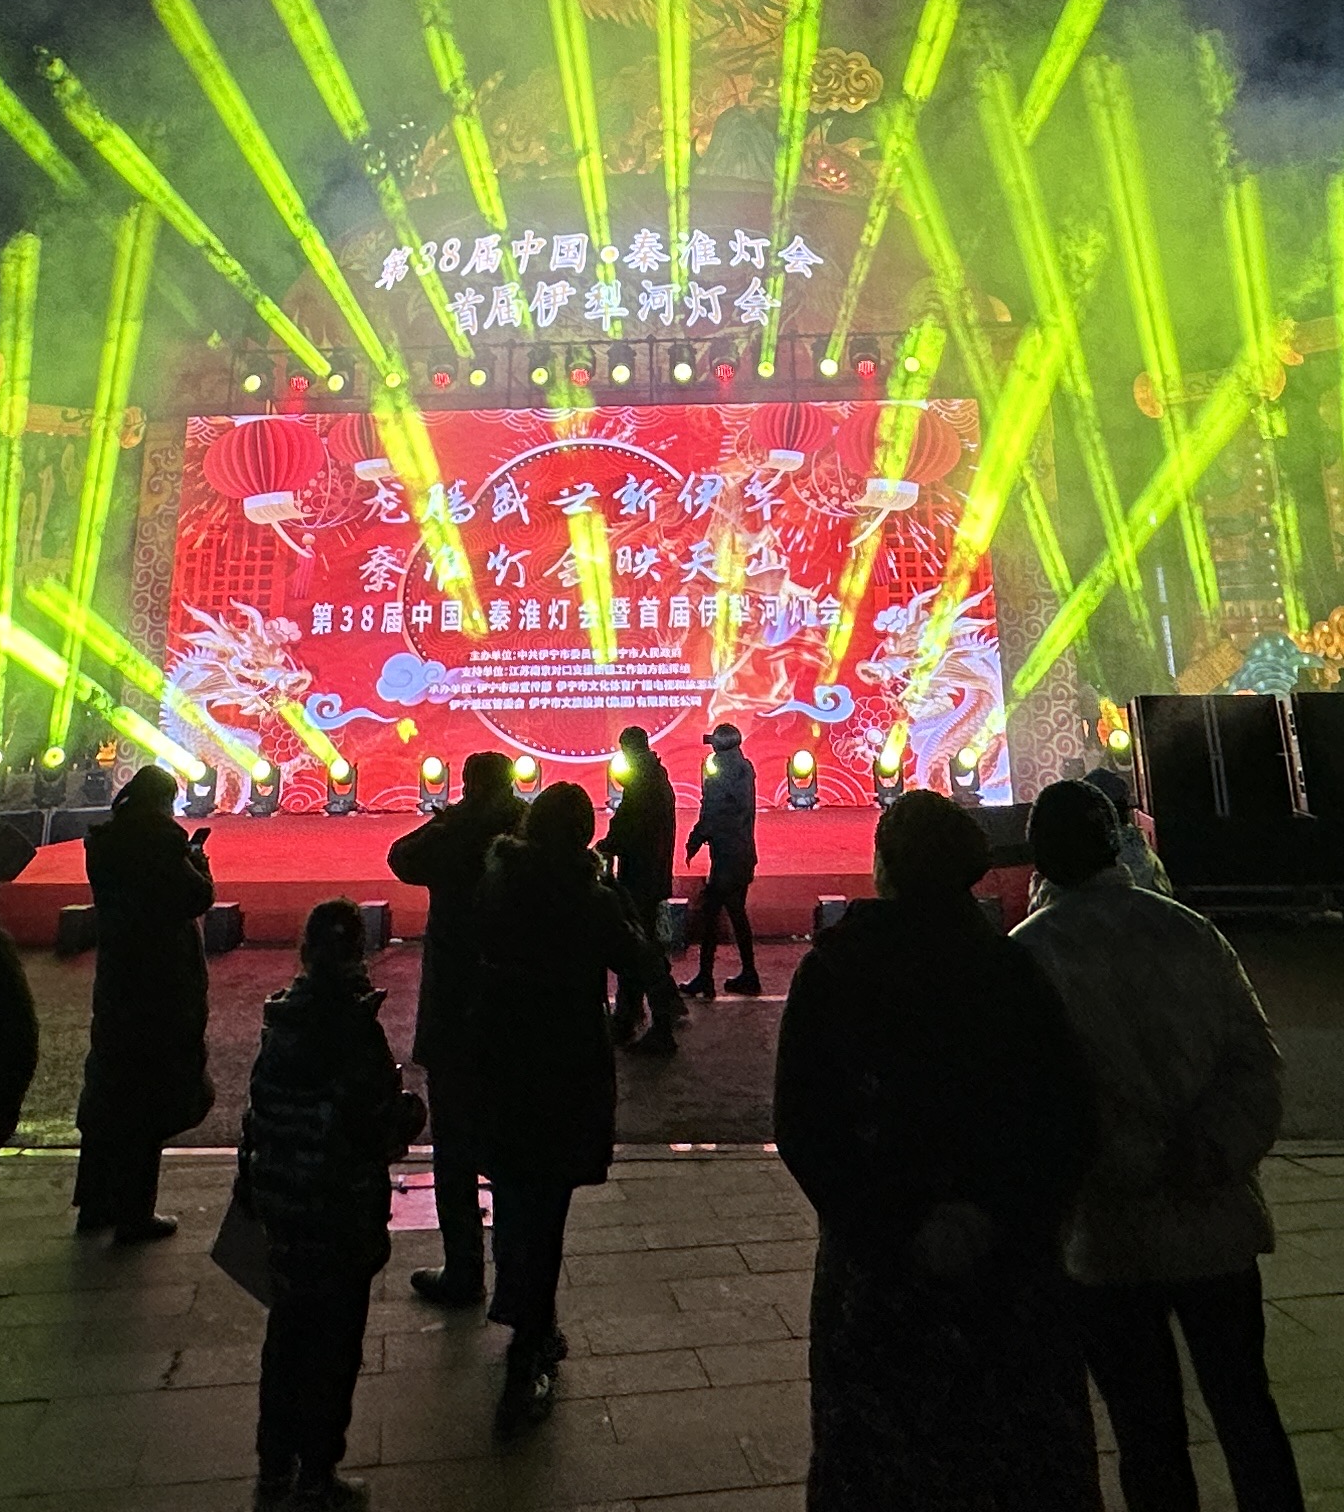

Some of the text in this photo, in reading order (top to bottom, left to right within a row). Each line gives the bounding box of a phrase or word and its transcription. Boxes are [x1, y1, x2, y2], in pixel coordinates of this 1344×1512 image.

[447, 277, 781, 335] 首届伊犁河灯会
[362, 470, 786, 524] 龙腾盛世新伊犁
[359, 541, 790, 592] 秦淮灯会映天山
[607, 646, 682, 660] 宁市人民政府
[555, 678, 720, 693] 伊宁市文化体育广播电视和旅游
